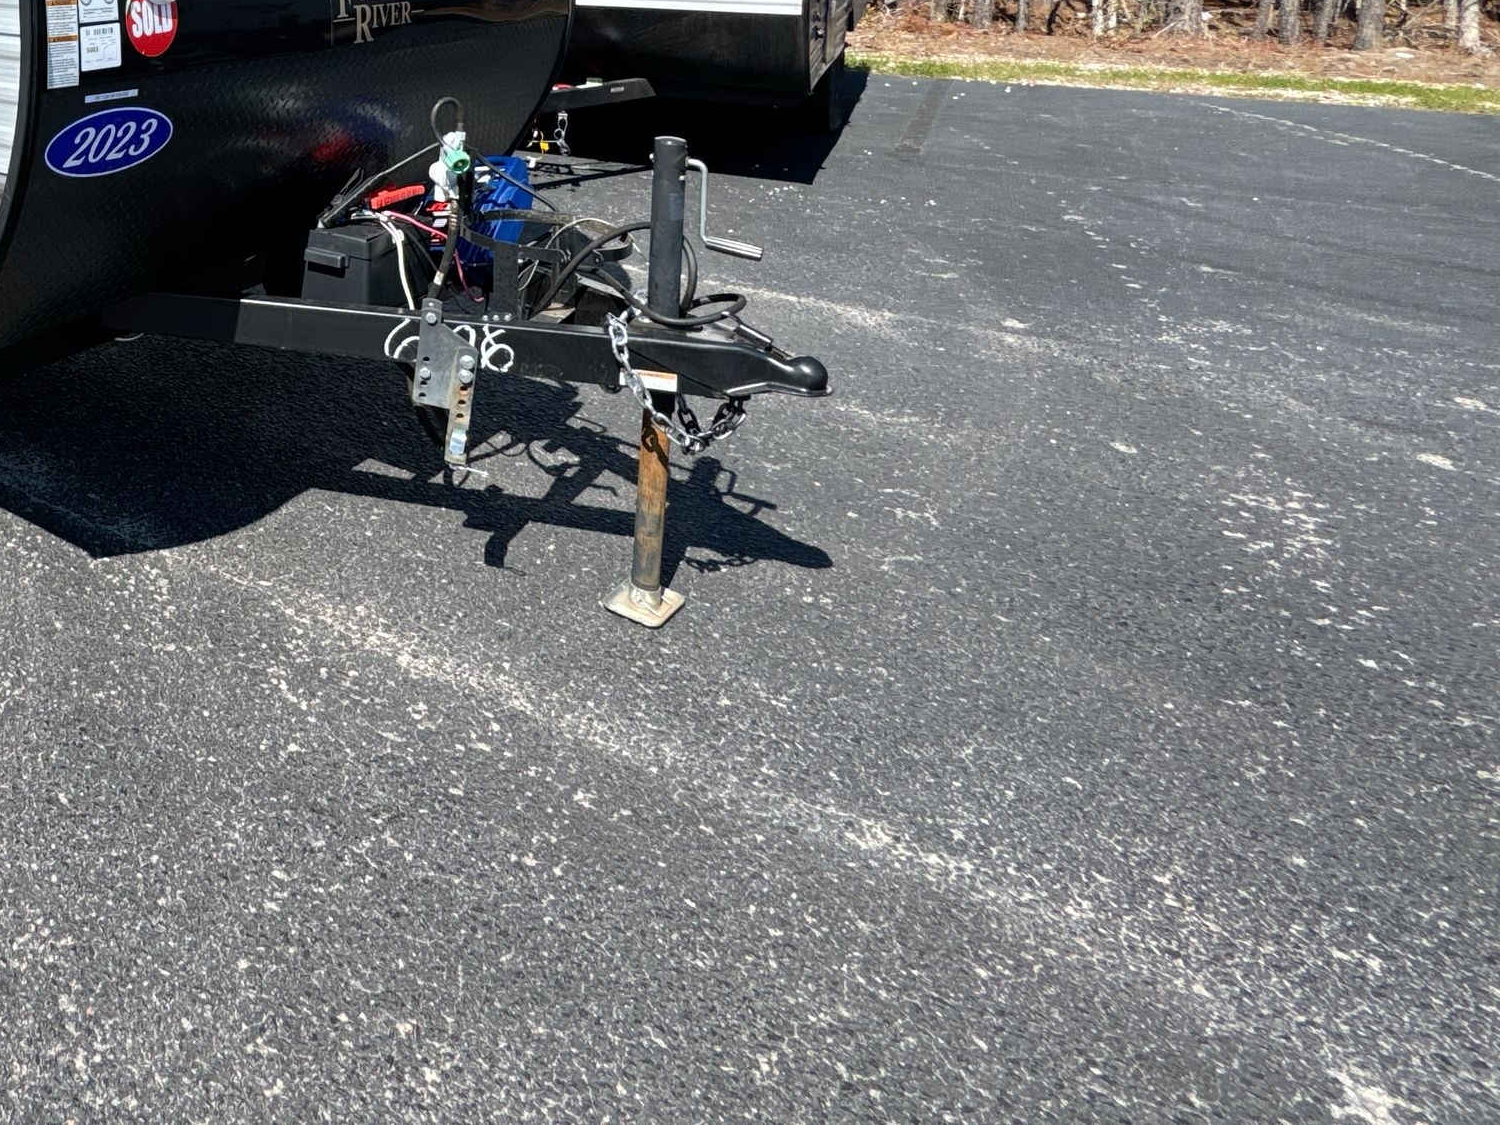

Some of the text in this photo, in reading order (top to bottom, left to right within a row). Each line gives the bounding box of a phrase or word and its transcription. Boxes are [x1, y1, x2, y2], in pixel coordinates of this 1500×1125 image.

[130, 0, 173, 38] SOLD
[353, 1, 412, 44] RIVER
[62, 118, 158, 168] 2023
